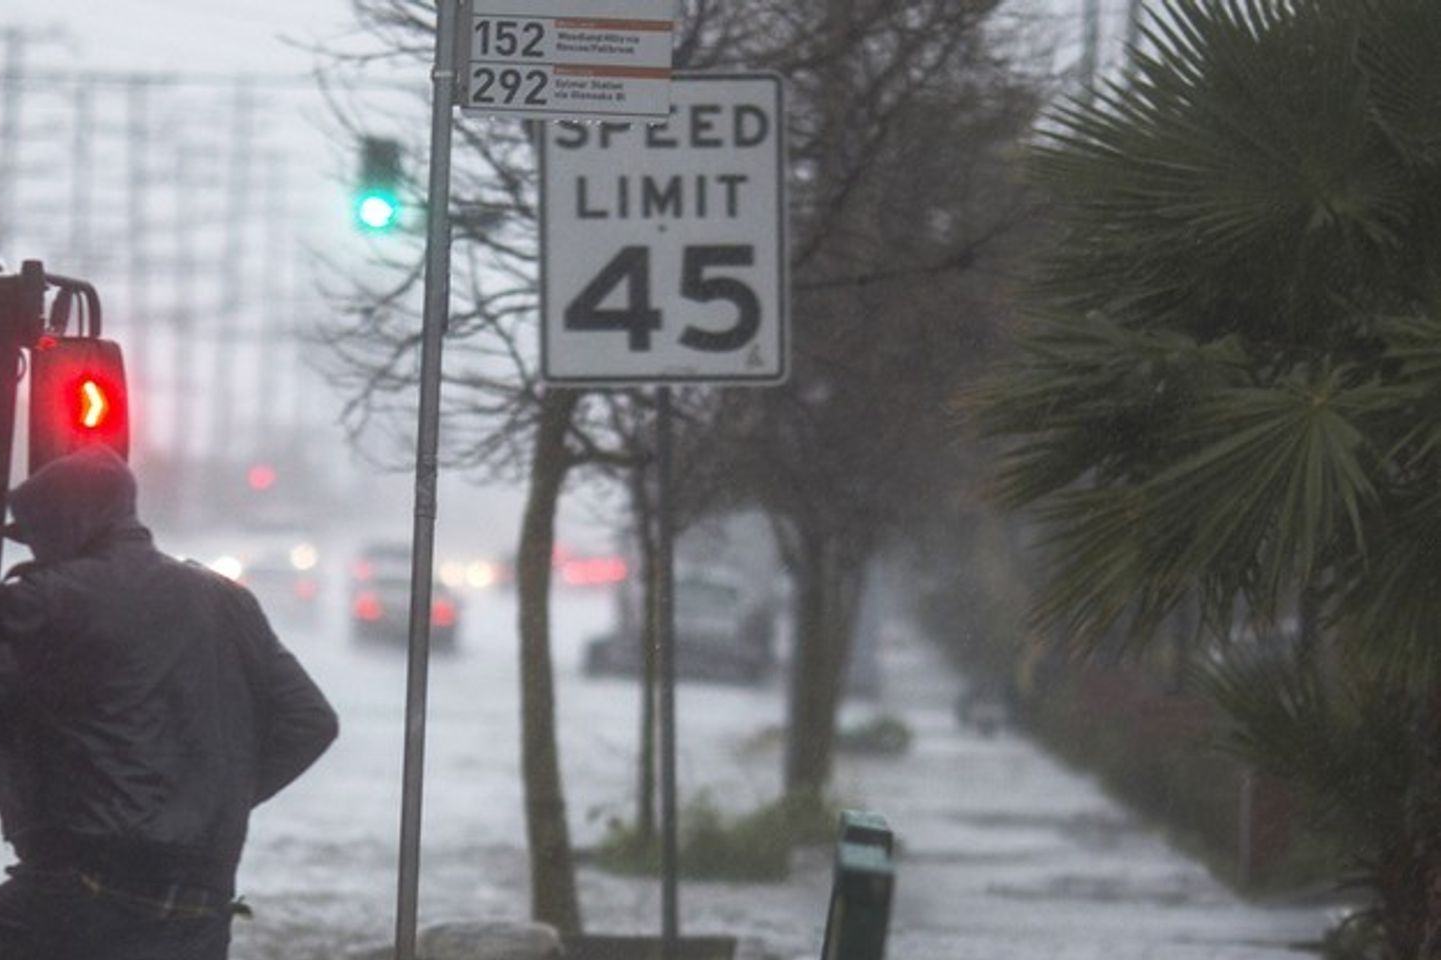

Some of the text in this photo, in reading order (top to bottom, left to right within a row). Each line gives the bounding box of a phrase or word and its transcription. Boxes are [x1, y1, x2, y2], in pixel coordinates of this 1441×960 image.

[475, 20, 545, 57] 152
[472, 67, 548, 106] 292
[576, 175, 748, 220] LIMIT
[563, 244, 763, 353] 45
